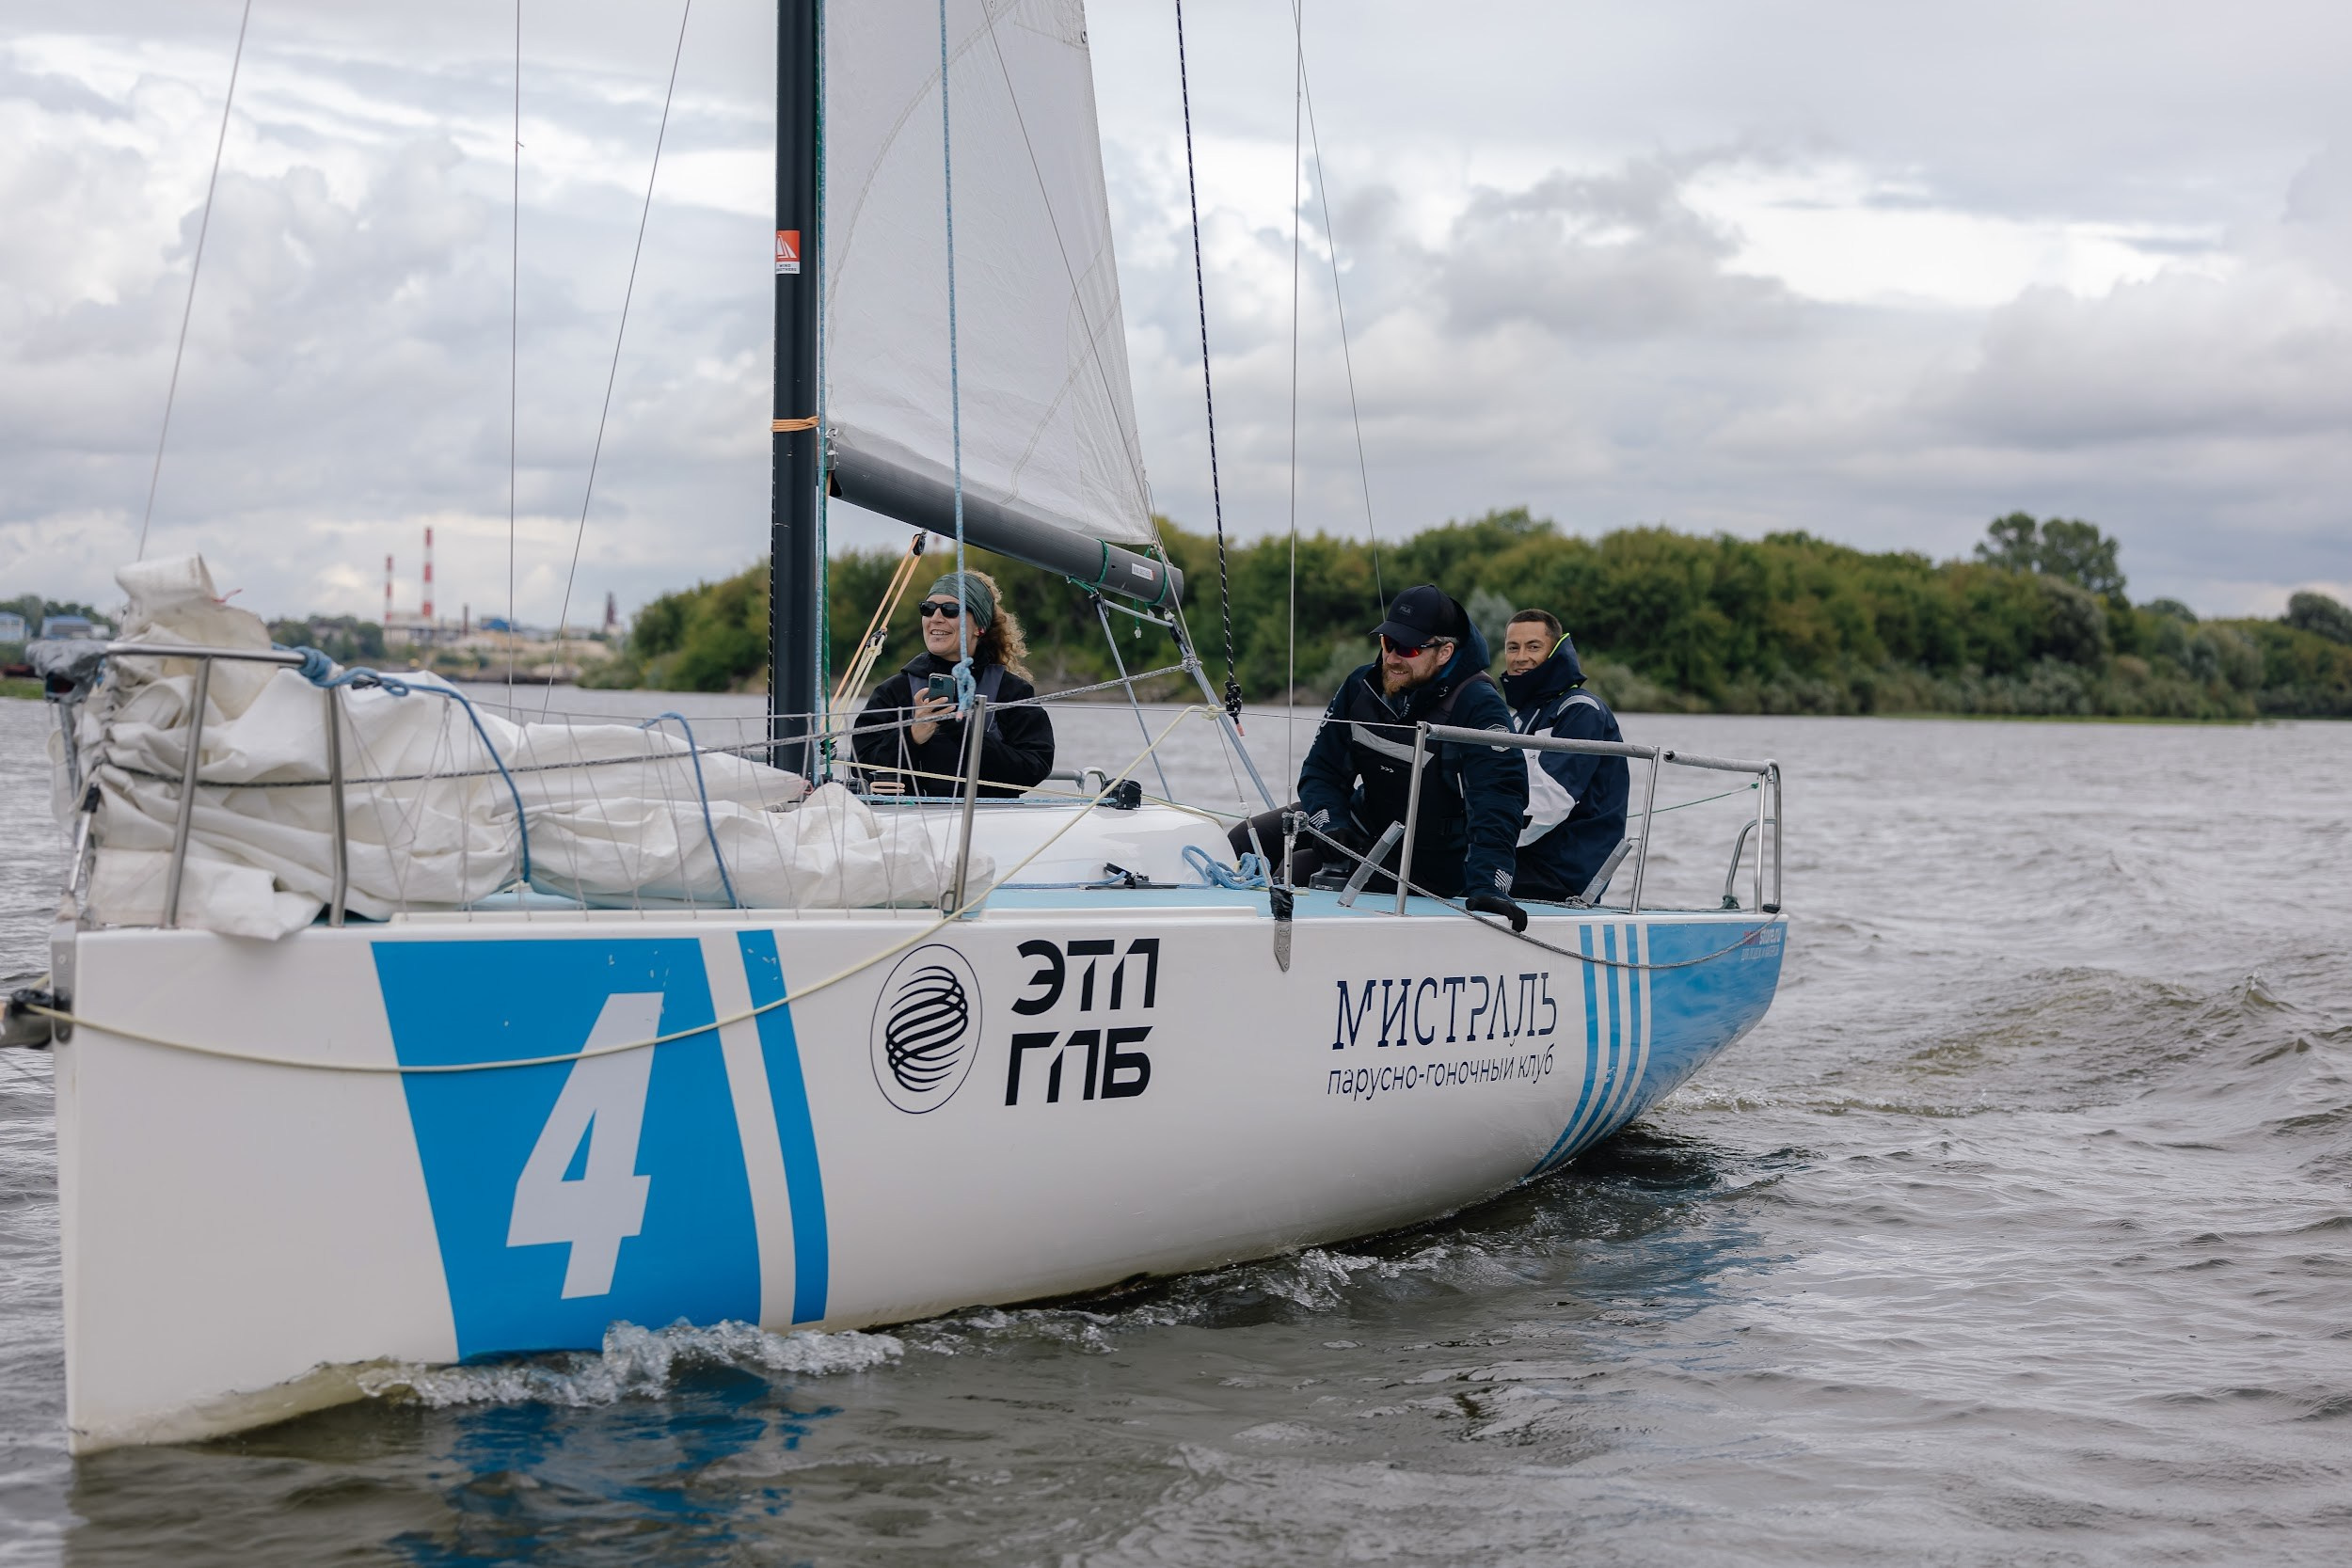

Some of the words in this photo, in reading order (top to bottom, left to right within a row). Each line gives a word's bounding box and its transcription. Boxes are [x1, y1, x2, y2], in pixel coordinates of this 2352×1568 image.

[1332, 972, 1557, 1051] МИСТРАЛЬ
[1327, 1037, 1515, 1101] парусно-гоночный
[1518, 1043, 1555, 1085] клуб
[506, 991, 664, 1300] 4
